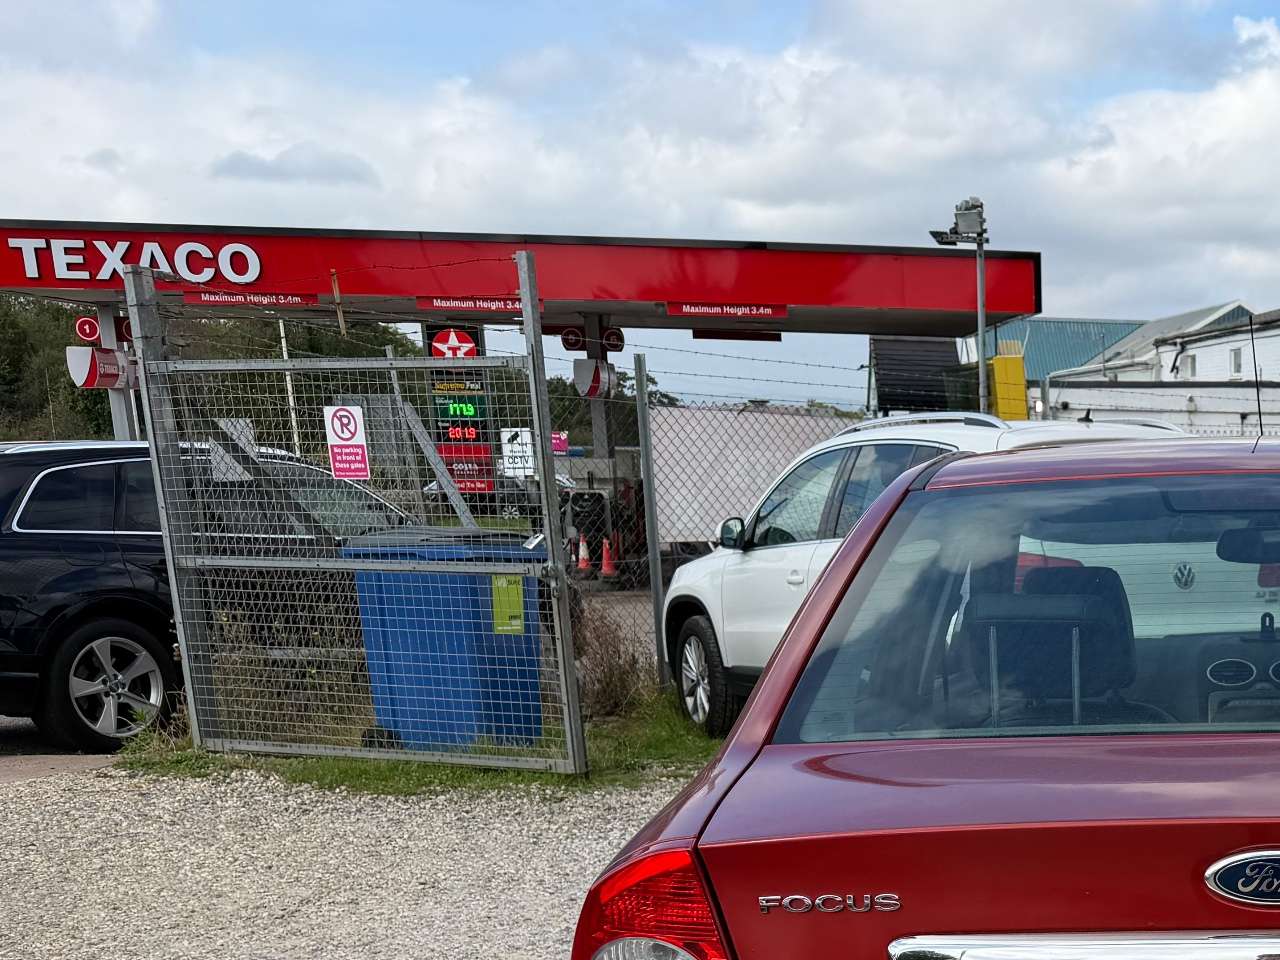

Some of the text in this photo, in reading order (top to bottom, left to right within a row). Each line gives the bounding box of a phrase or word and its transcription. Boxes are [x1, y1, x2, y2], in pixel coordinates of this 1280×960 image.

[8, 237, 261, 285] TEXACO
[201, 292, 301, 305] Maximum Height 3.4m
[433, 298, 524, 309] Maximum Height 3.4
[682, 304, 773, 316] Maximum Height 3.4m
[83, 323, 90, 334] 1
[507, 456, 530, 465] CCTV
[758, 893, 901, 914] FOCUS
